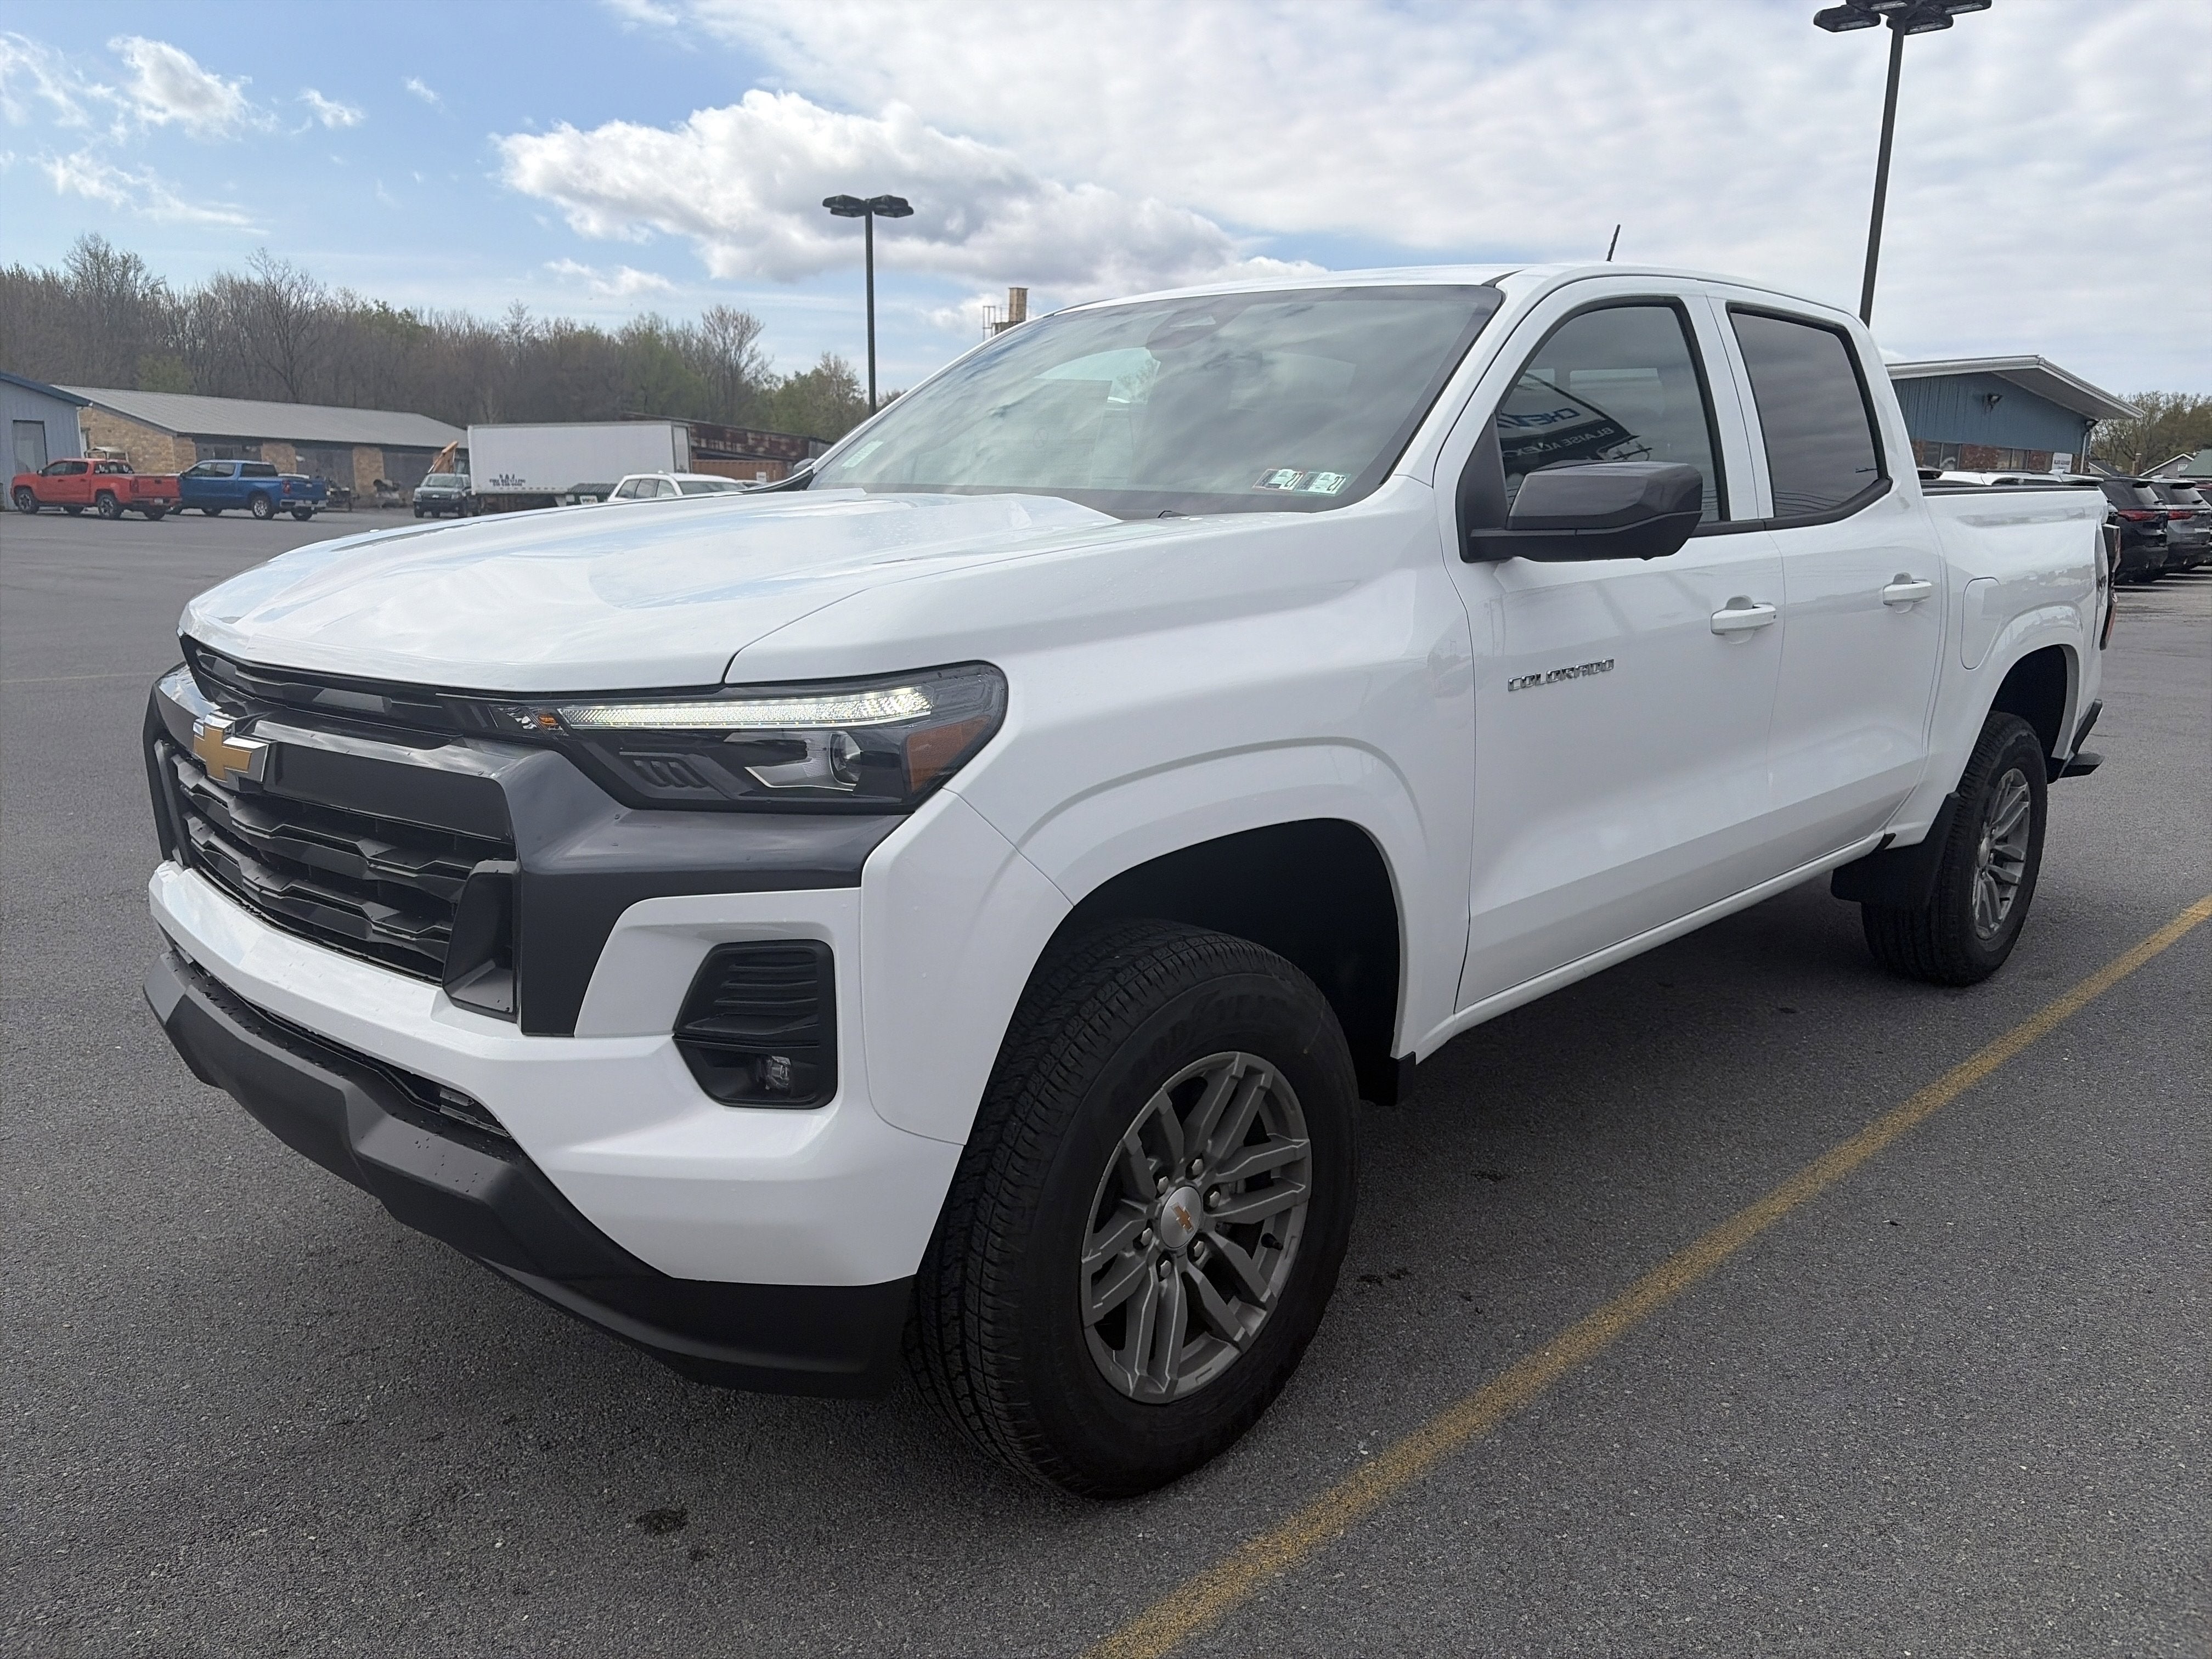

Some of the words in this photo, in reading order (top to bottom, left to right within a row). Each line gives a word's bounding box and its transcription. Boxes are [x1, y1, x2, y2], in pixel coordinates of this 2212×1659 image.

[1284, 472, 1303, 488] 27
[1326, 476, 1346, 492] 27
[1508, 658, 1615, 692] COLORADO
